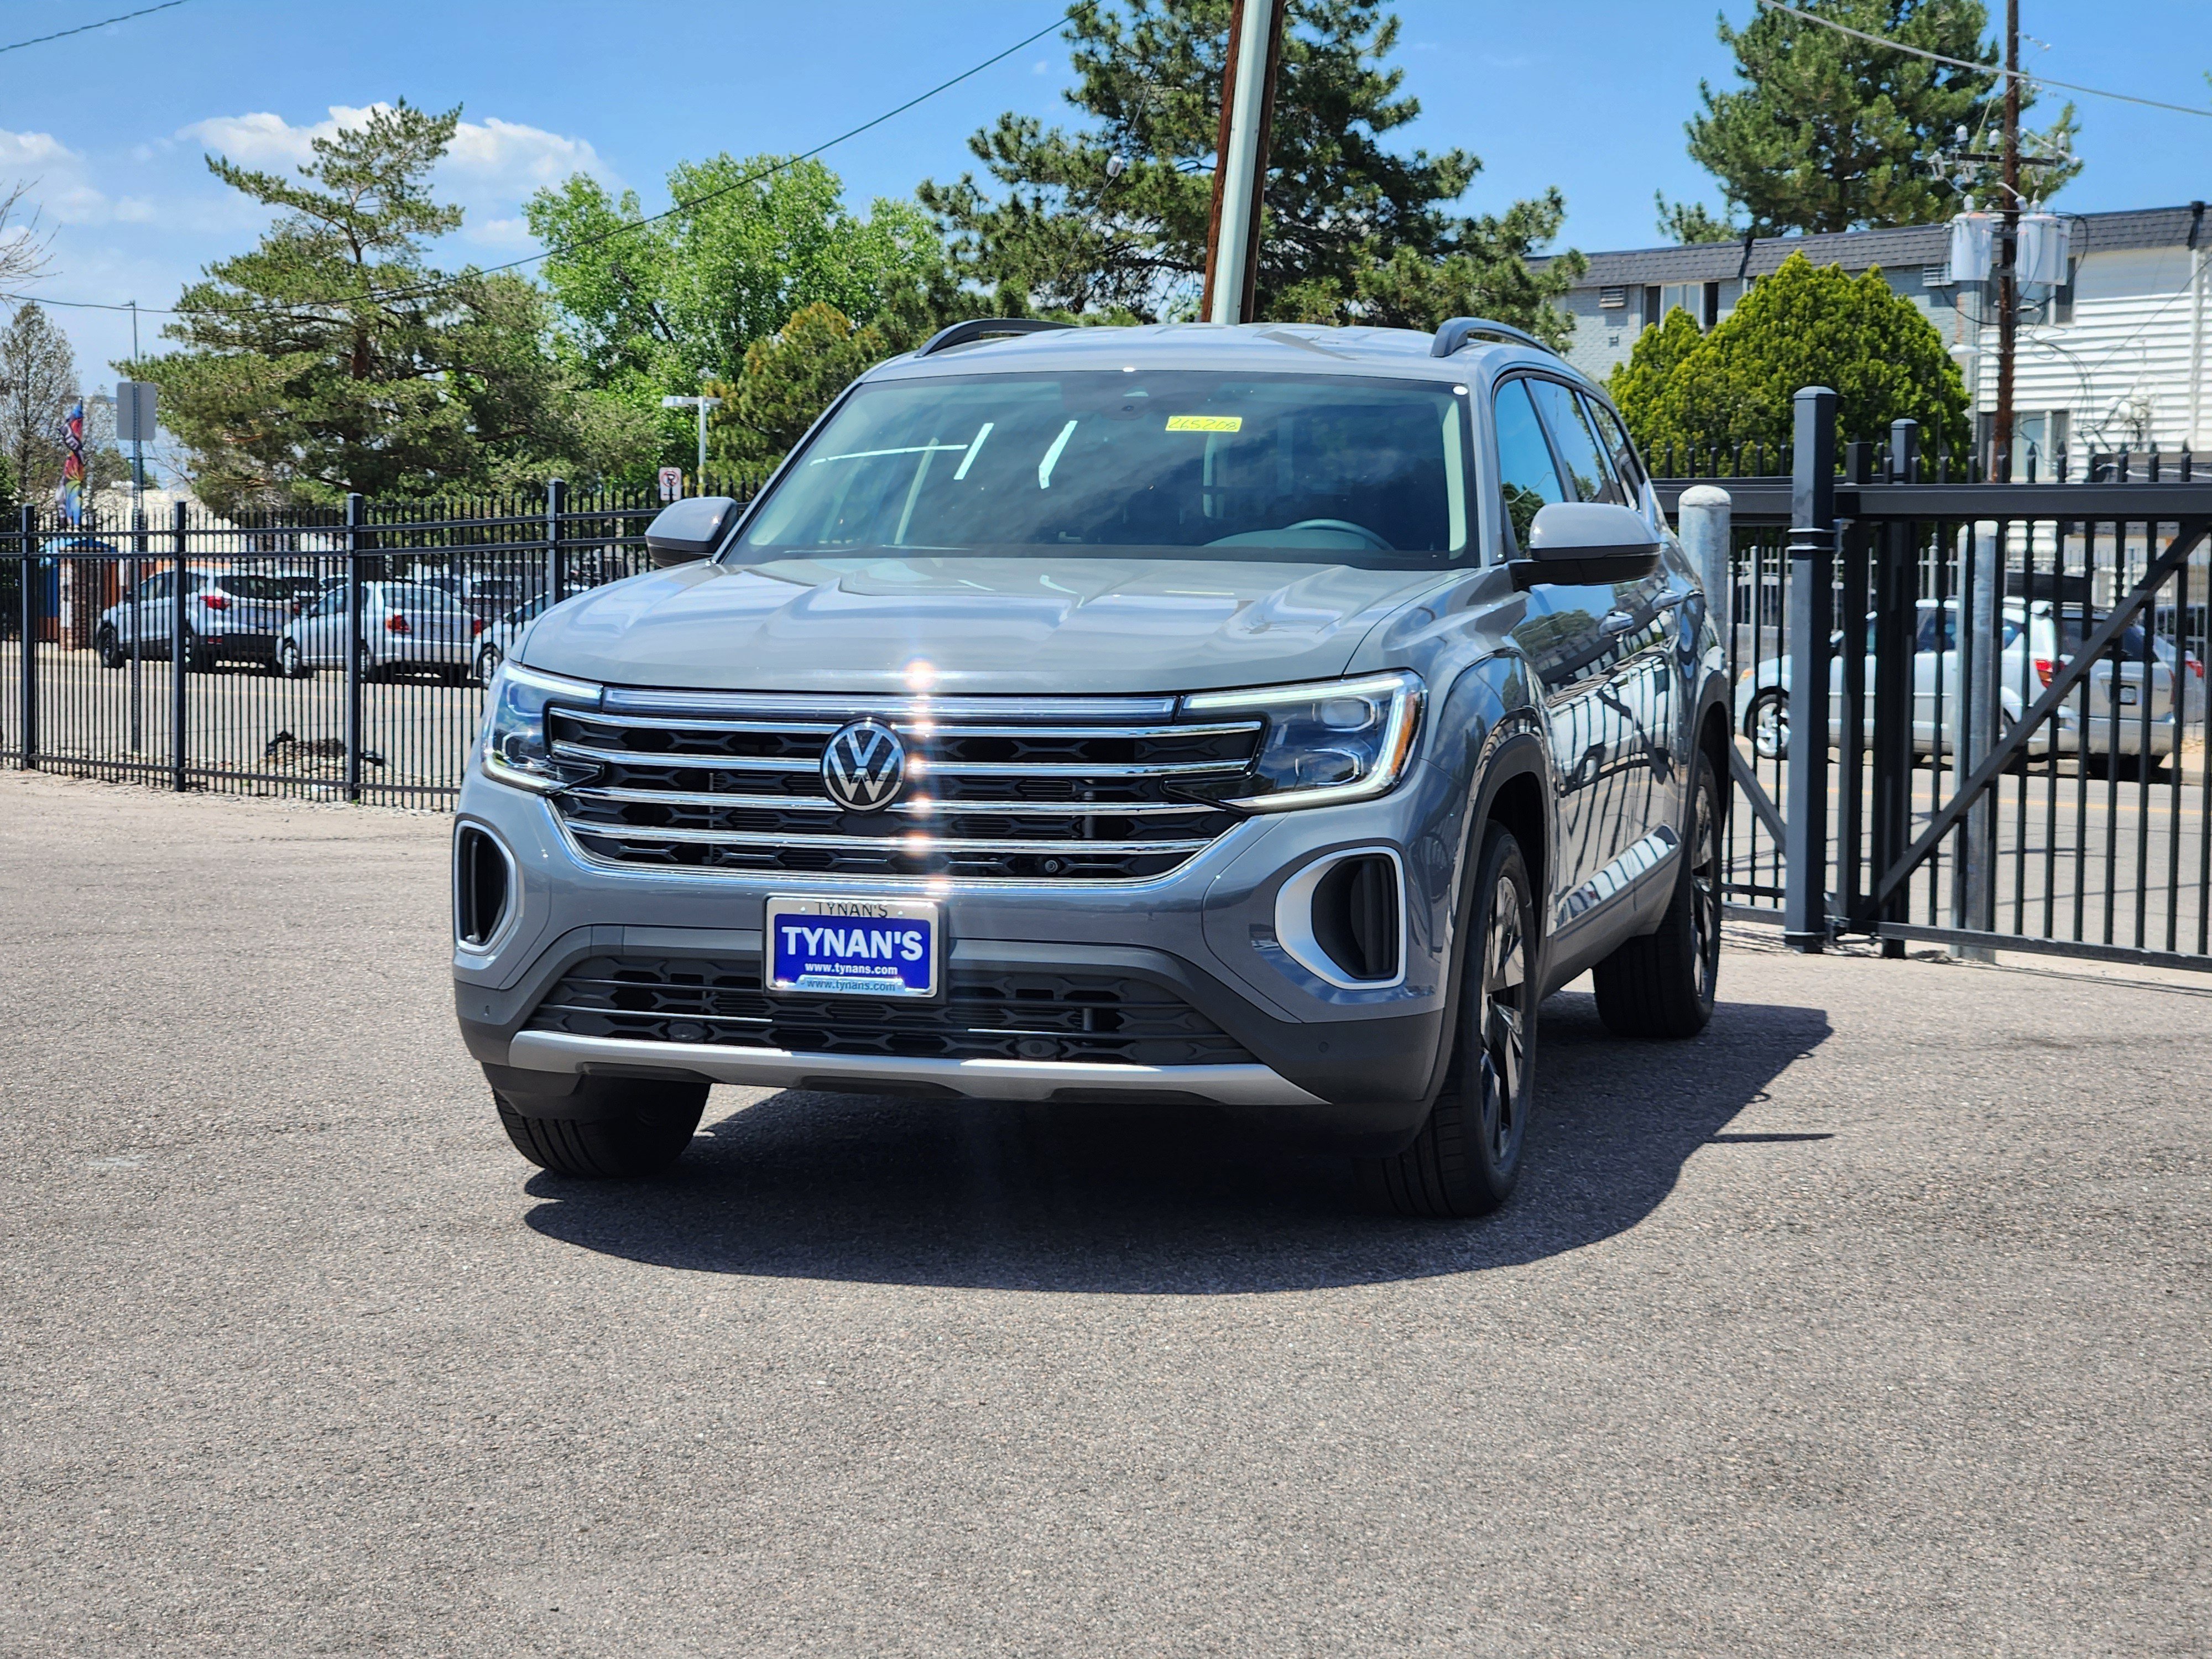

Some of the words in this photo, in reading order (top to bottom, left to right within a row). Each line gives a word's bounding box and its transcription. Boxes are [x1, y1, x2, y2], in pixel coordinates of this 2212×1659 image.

[1168, 417, 1237, 431] 265208
[815, 901, 888, 918] TYNAN'S
[781, 926, 924, 961] TYNAN'S
[804, 962, 898, 975] www.tynans.com
[806, 979, 896, 992] www.tynans.com
